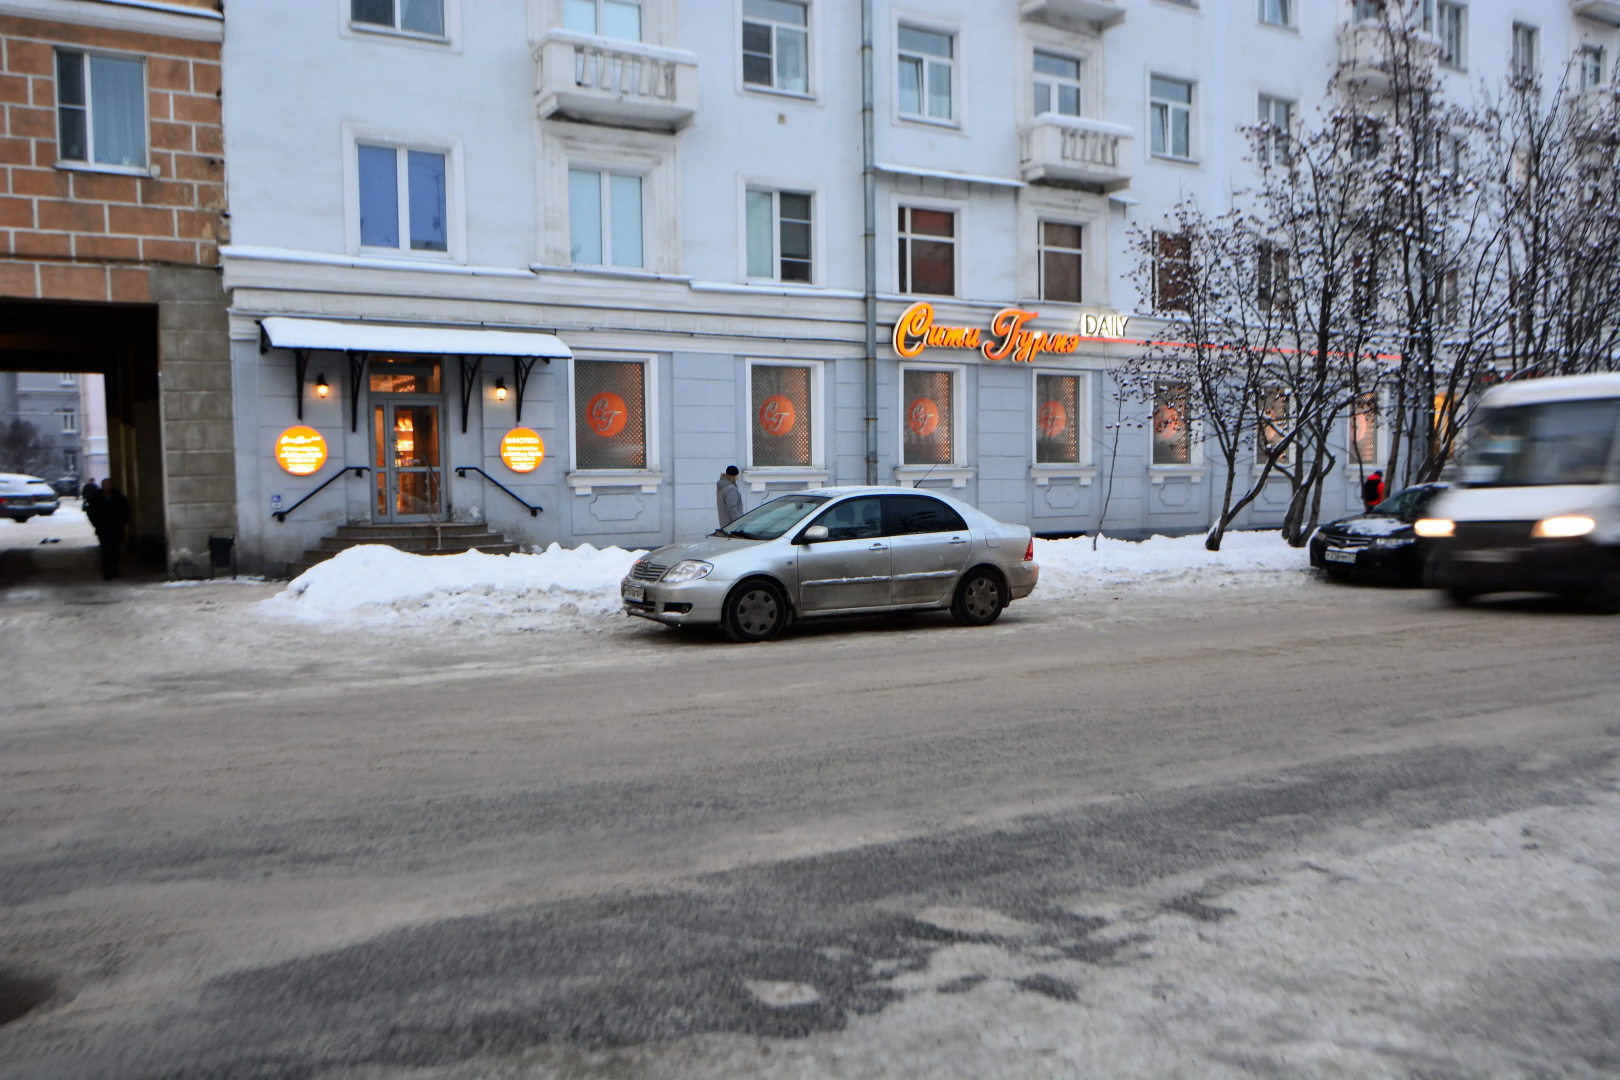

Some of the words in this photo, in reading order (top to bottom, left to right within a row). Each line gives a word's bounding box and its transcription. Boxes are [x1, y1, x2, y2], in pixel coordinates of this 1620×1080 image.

[893, 301, 980, 358] Сити
[981, 307, 1080, 362] Гурмэ
[1080, 313, 1130, 338] DAILY
